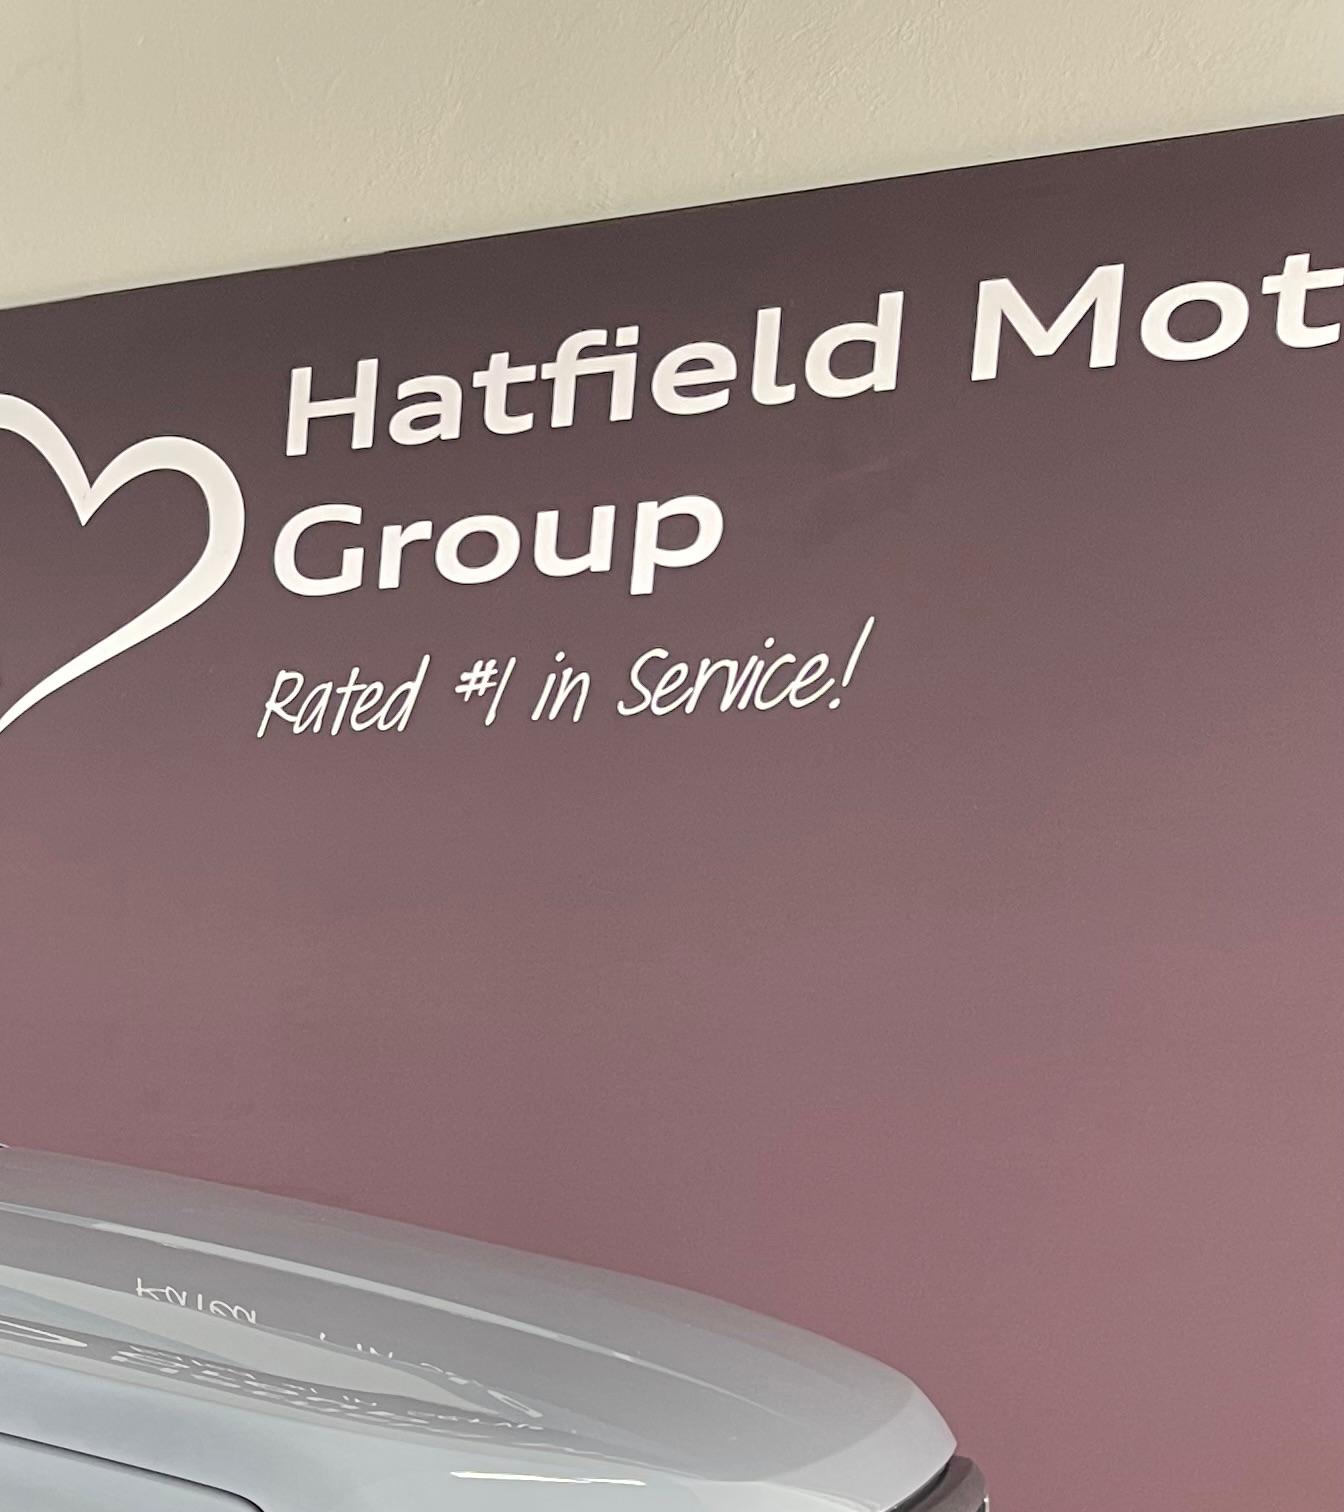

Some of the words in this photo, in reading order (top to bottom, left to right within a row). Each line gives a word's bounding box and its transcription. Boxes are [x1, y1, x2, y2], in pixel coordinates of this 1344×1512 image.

[286, 290, 904, 457] Hatfield
[971, 253, 1344, 381] Mot
[273, 494, 724, 596] Group
[256, 654, 431, 738] Rated
[455, 656, 515, 727] #1
[531, 650, 591, 722] in
[616, 615, 875, 717] Service!
